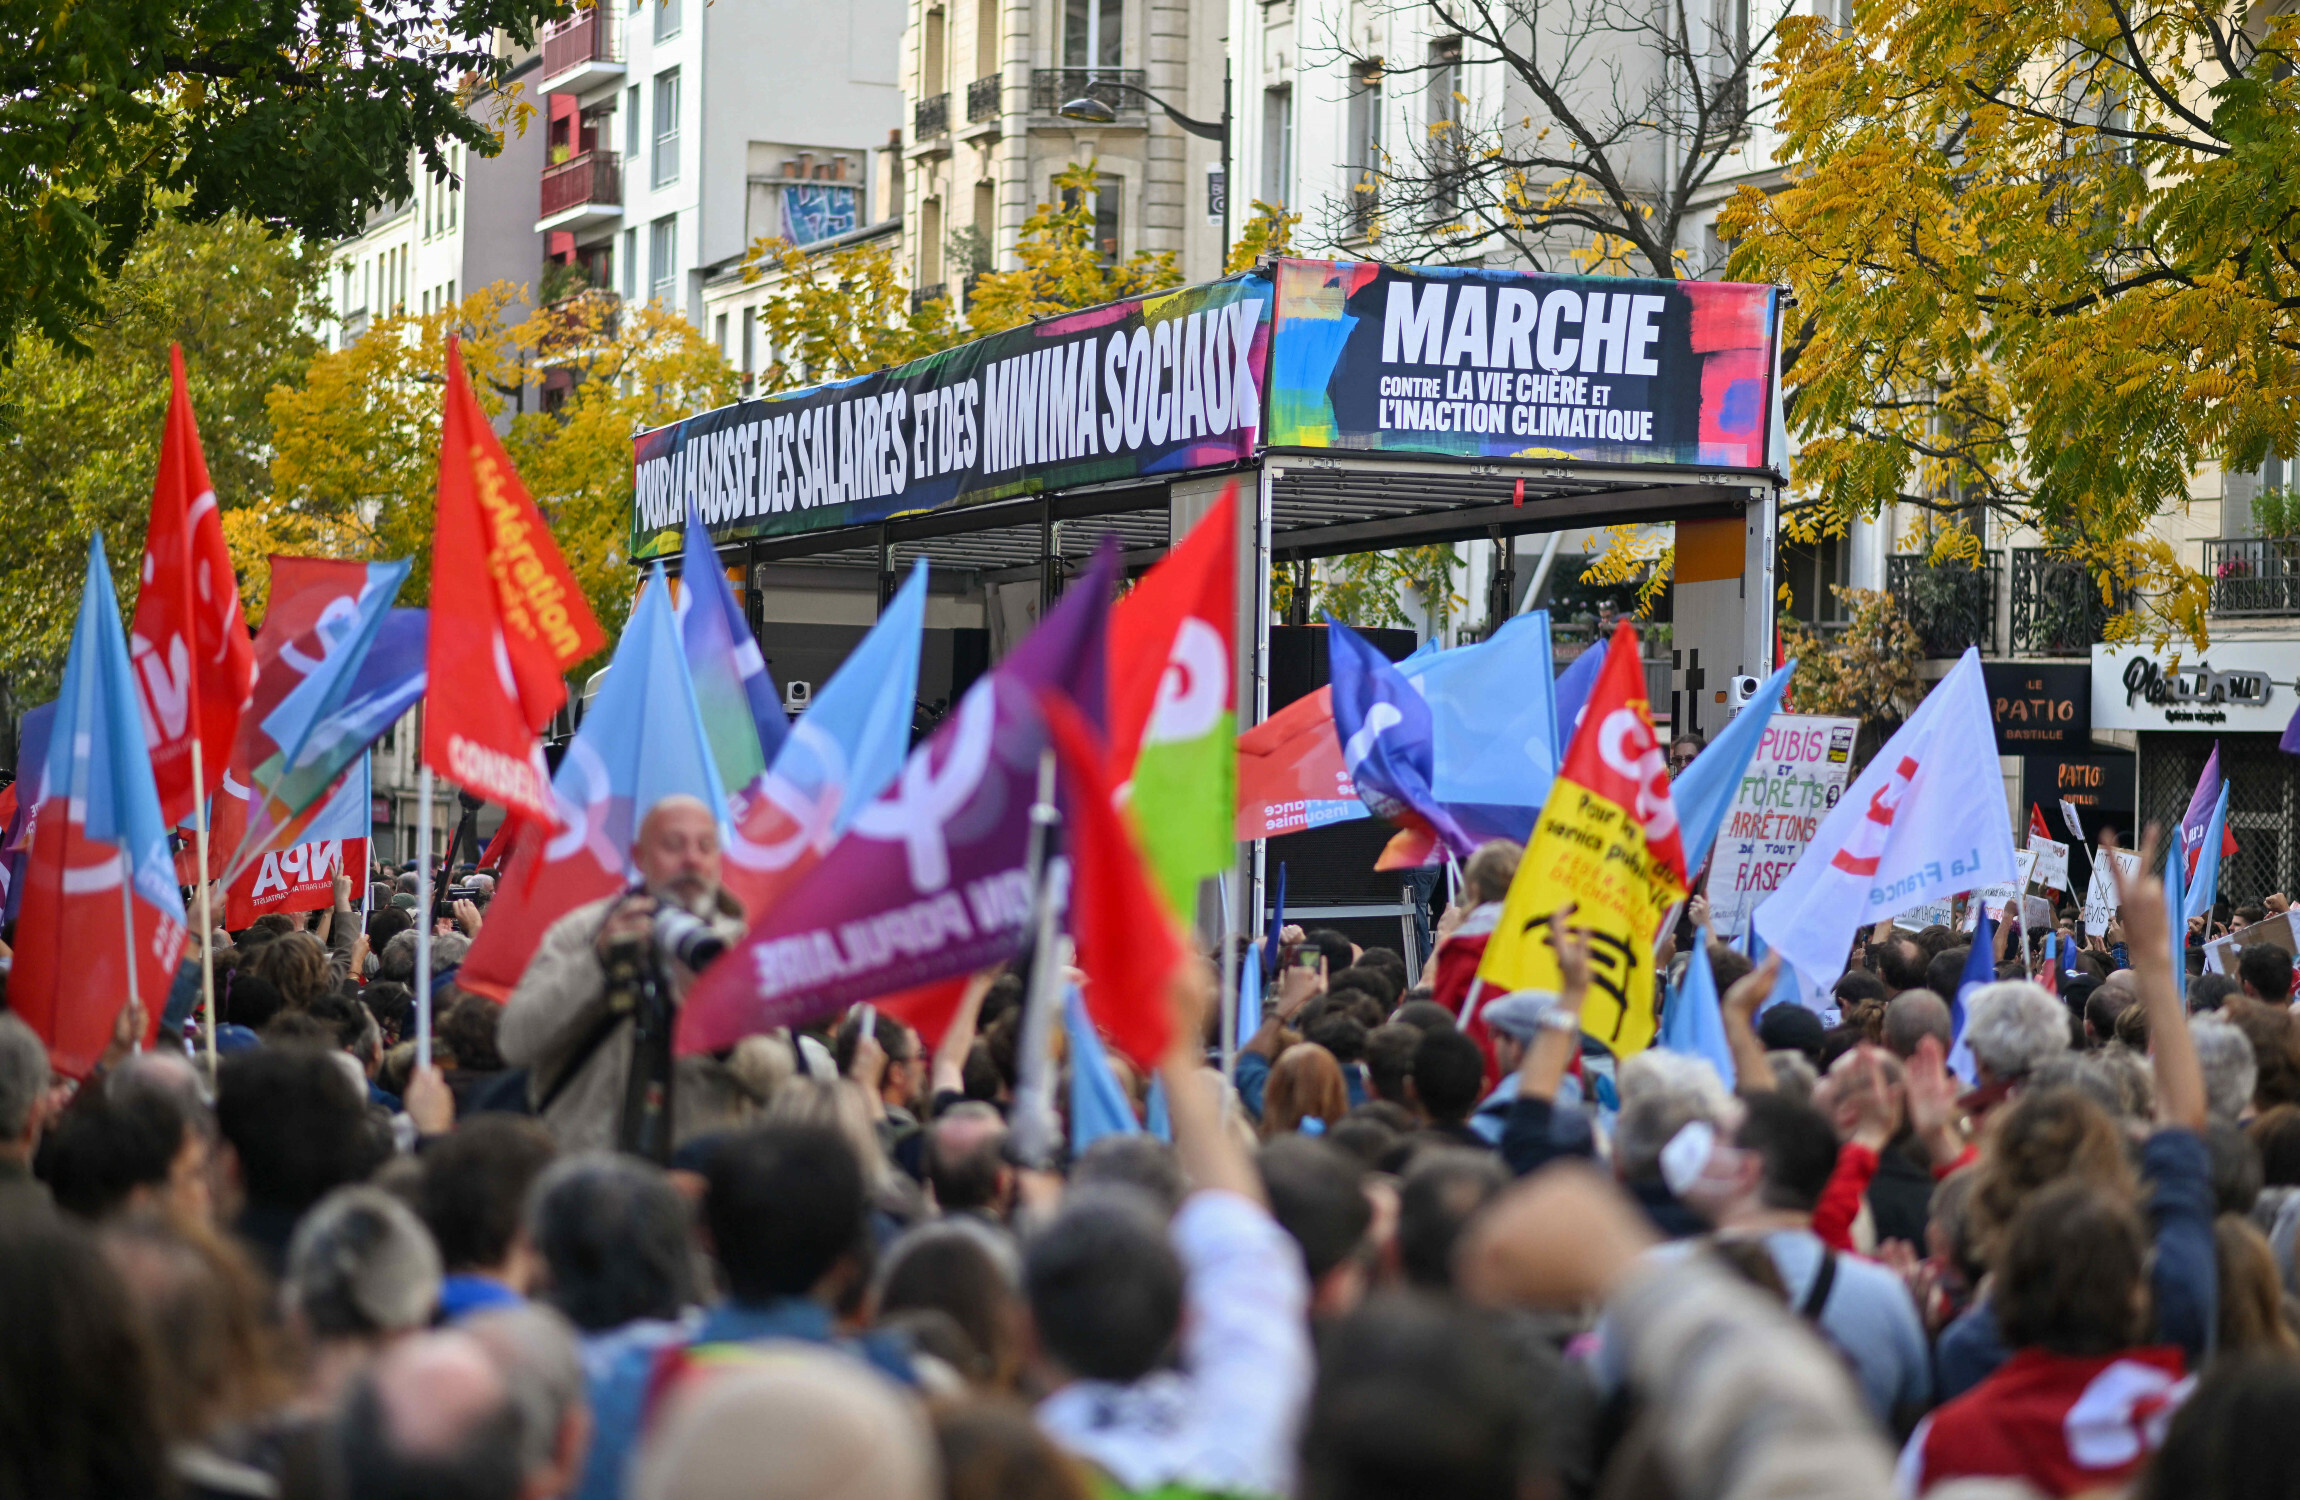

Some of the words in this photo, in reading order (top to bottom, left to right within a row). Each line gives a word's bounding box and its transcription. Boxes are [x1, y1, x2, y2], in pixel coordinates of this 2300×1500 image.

[1381, 281, 1666, 376] MARCHE
[1380, 376, 1441, 399] CONTRE
[1446, 370, 1473, 400] LA
[1477, 371, 1513, 402] VIE
[1516, 368, 1588, 404] CHÈRE
[1592, 385, 1611, 406] ET
[635, 456, 671, 533] POUR
[668, 451, 684, 525] LA
[685, 422, 759, 528] HAUSSE
[758, 412, 796, 516] DES
[797, 387, 907, 510] SALAIRES
[914, 390, 938, 479] ET
[938, 377, 979, 475] DES
[983, 337, 1099, 475] MINIMA
[1102, 298, 1264, 453] SOCIAUX
[1379, 399, 1506, 433] L'INACTION
[1512, 405, 1653, 441] CLIMATIQUE
[2027, 680, 2043, 690] LE
[1995, 697, 2074, 723] PATIO
[2006, 729, 2063, 740] BASTILLE
[1777, 765, 1792, 776] ET
[2058, 763, 2100, 788] PATIO
[1739, 775, 1824, 809] FORÊTS
[1729, 809, 1816, 843] ARRÊTONS
[1738, 844, 1754, 854] DE
[1765, 844, 1795, 855] TOUT
